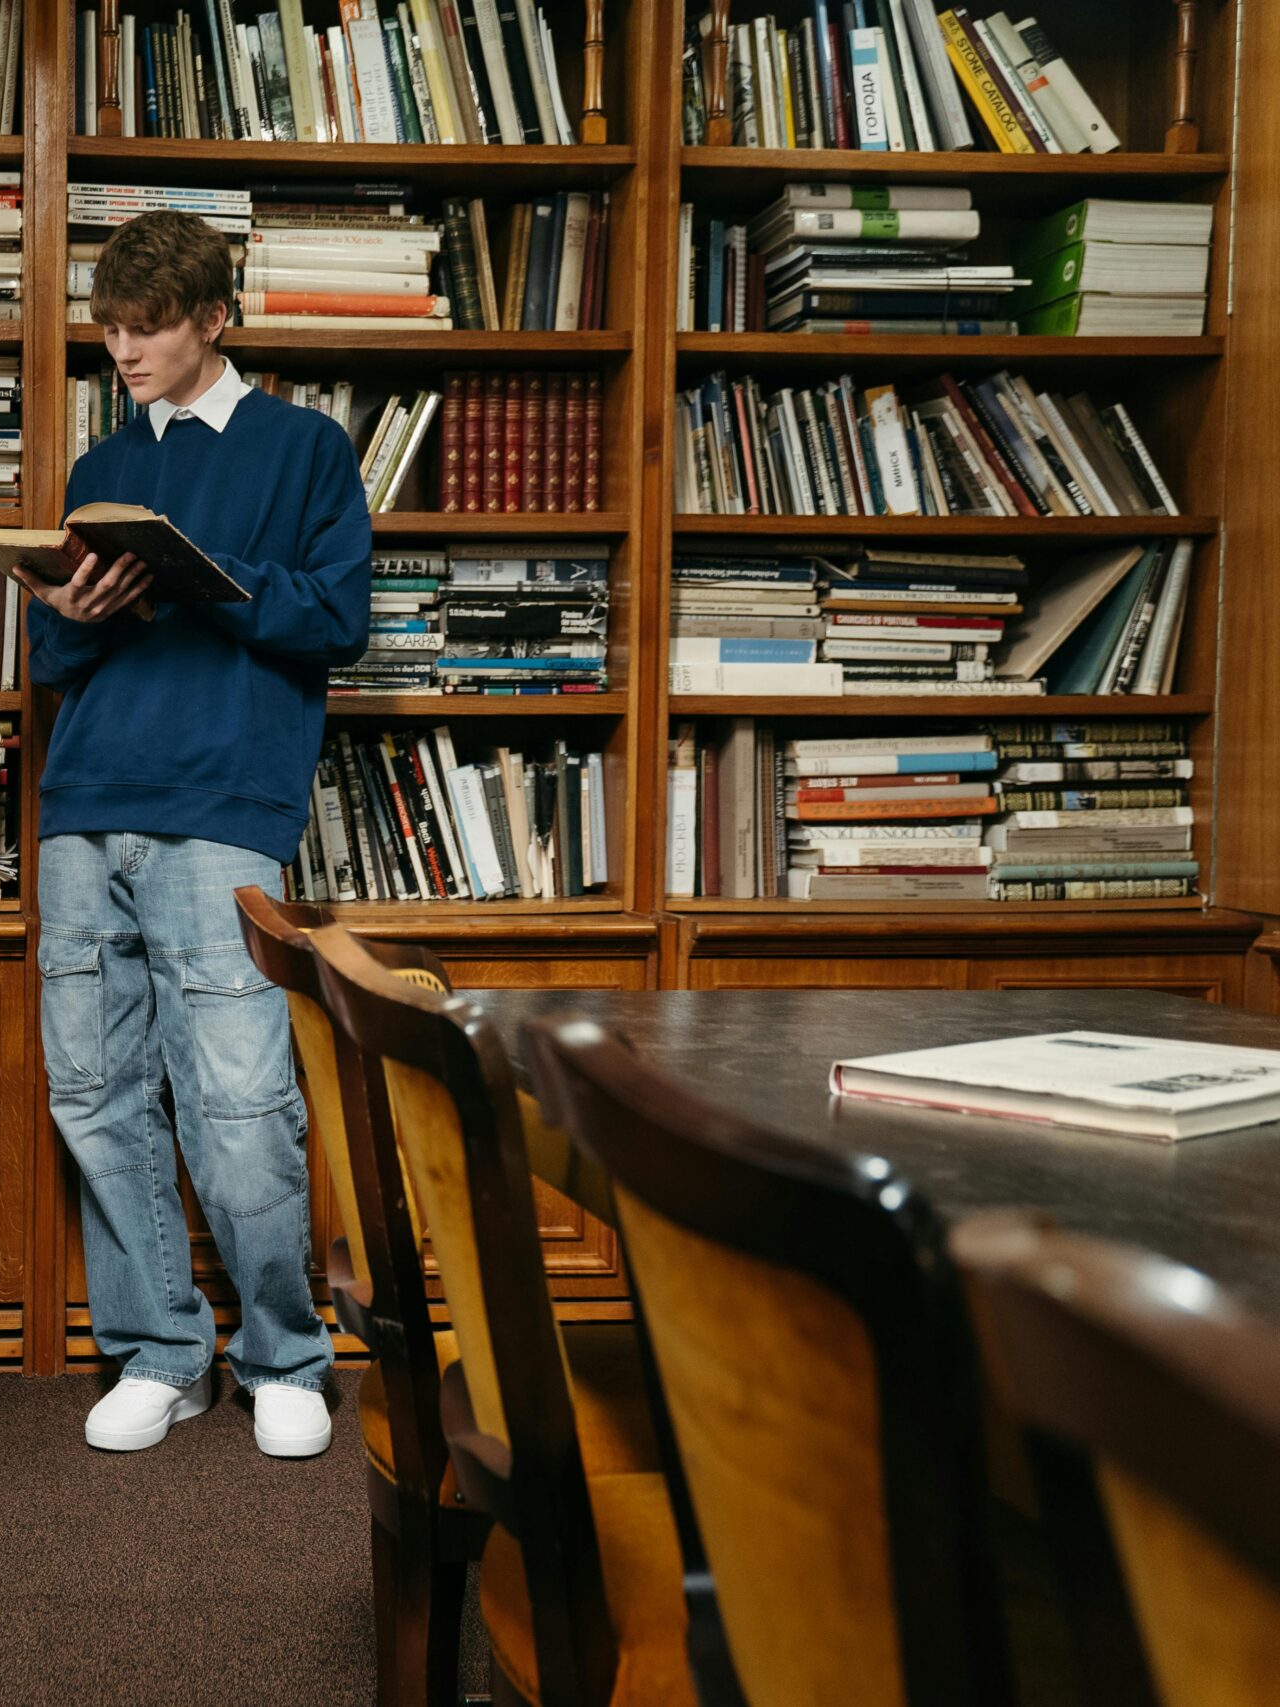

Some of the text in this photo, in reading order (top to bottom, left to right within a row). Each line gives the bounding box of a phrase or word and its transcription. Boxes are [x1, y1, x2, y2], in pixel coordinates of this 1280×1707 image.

[956, 37, 985, 76] STONE
[983, 80, 1018, 133] CATALOG
[861, 72, 878, 137] ГОРОДА
[888, 450, 904, 489] МИНСК
[385, 634, 439, 648] SCARPA
[393, 665, 400, 673] in
[401, 665, 414, 673] der
[414, 664, 431, 674] DDR
[421, 788, 433, 811] Bach
[418, 821, 432, 844] Bach
